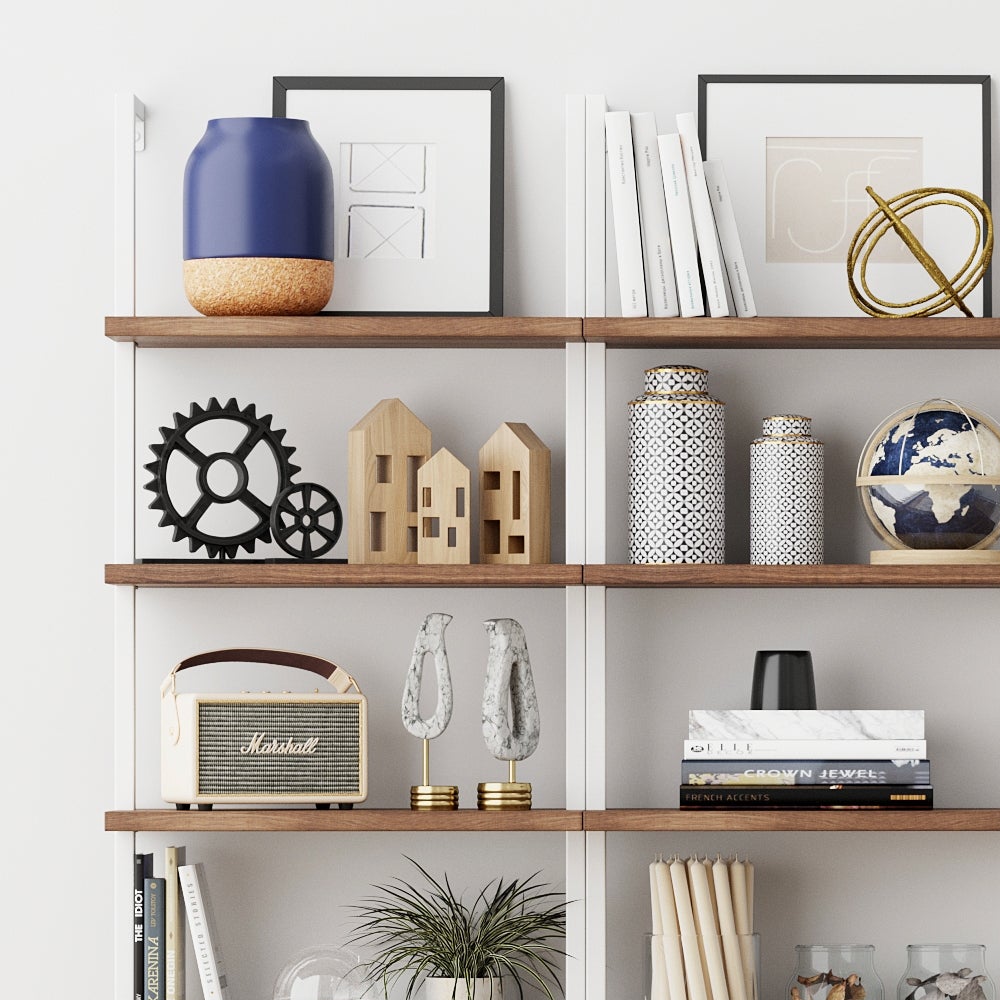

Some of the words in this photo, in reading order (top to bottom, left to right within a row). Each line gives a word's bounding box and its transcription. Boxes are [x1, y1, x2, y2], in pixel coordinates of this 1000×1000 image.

[240, 732, 320, 755] Marshall
[743, 769, 813, 778] CROWN
[818, 769, 878, 778] JEWEL
[685, 793, 723, 801] FRENCH
[726, 793, 770, 801] ACCENTS
[134, 888, 143, 918] IDIOT
[187, 883, 202, 927] STORIES
[134, 924, 143, 943] THE
[166, 949, 176, 995] ONEGIN
[197, 934, 213, 984] SELECTED
